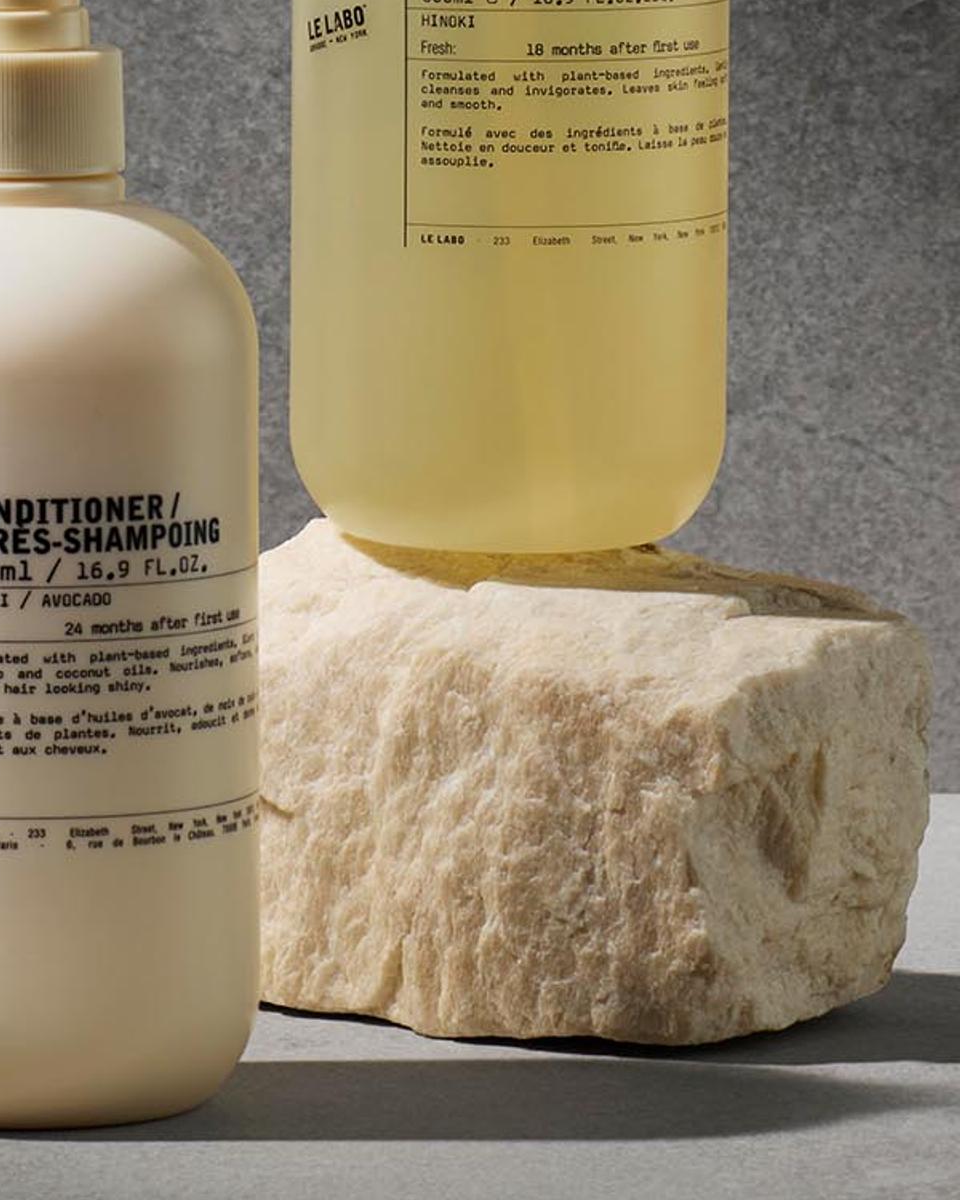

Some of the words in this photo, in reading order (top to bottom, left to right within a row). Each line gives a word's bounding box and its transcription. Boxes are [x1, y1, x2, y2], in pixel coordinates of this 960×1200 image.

[421, 14, 475, 28] HINOKI
[307, 17, 322, 40] LE
[421, 40, 456, 55] Fresh:
[527, 43, 544, 56] 18
[551, 42, 602, 56] months
[610, 42, 647, 55] after
[653, 40, 679, 53] first
[513, 71, 545, 82] with
[562, 70, 639, 83] plant-based
[421, 84, 480, 95] cleanses
[491, 86, 514, 96] and
[525, 85, 612, 98] invigorates.
[623, 84, 660, 94] Leaves
[421, 99, 442, 109] and
[450, 100, 502, 111] smooth.
[486, 130, 516, 139] avec
[530, 129, 553, 139] des
[566, 126, 642, 140] ingrédients
[421, 141, 472, 152] Nettoie
[479, 144, 495, 153] en
[502, 143, 555, 153] douceur
[562, 142, 576, 153] et
[421, 156, 494, 168] assouplie.
[493, 236, 510, 245] 233
[77, 560, 129, 581] 16.9
[145, 554, 207, 576] FL.OZ.
[42, 592, 111, 608] AVOCADO
[65, 622, 83, 636] 24
[91, 619, 143, 635] months
[150, 616, 188, 631] after
[194, 610, 223, 626] first
[43, 652, 76, 664] with
[90, 648, 169, 664] plant-based
[17, 668, 42, 680] and
[55, 666, 110, 679] coconut
[123, 664, 158, 676] oils.
[4, 683, 37, 695] hair
[45, 682, 100, 695] looking
[108, 680, 151, 693] shiny.
[30, 713, 63, 725] base
[25, 729, 41, 740] de
[54, 728, 116, 741] plantes.
[128, 722, 181, 736] Nourrit,
[12, 746, 37, 756] aux
[44, 744, 107, 756] cheveux.
[28, 828, 46, 839] 233
